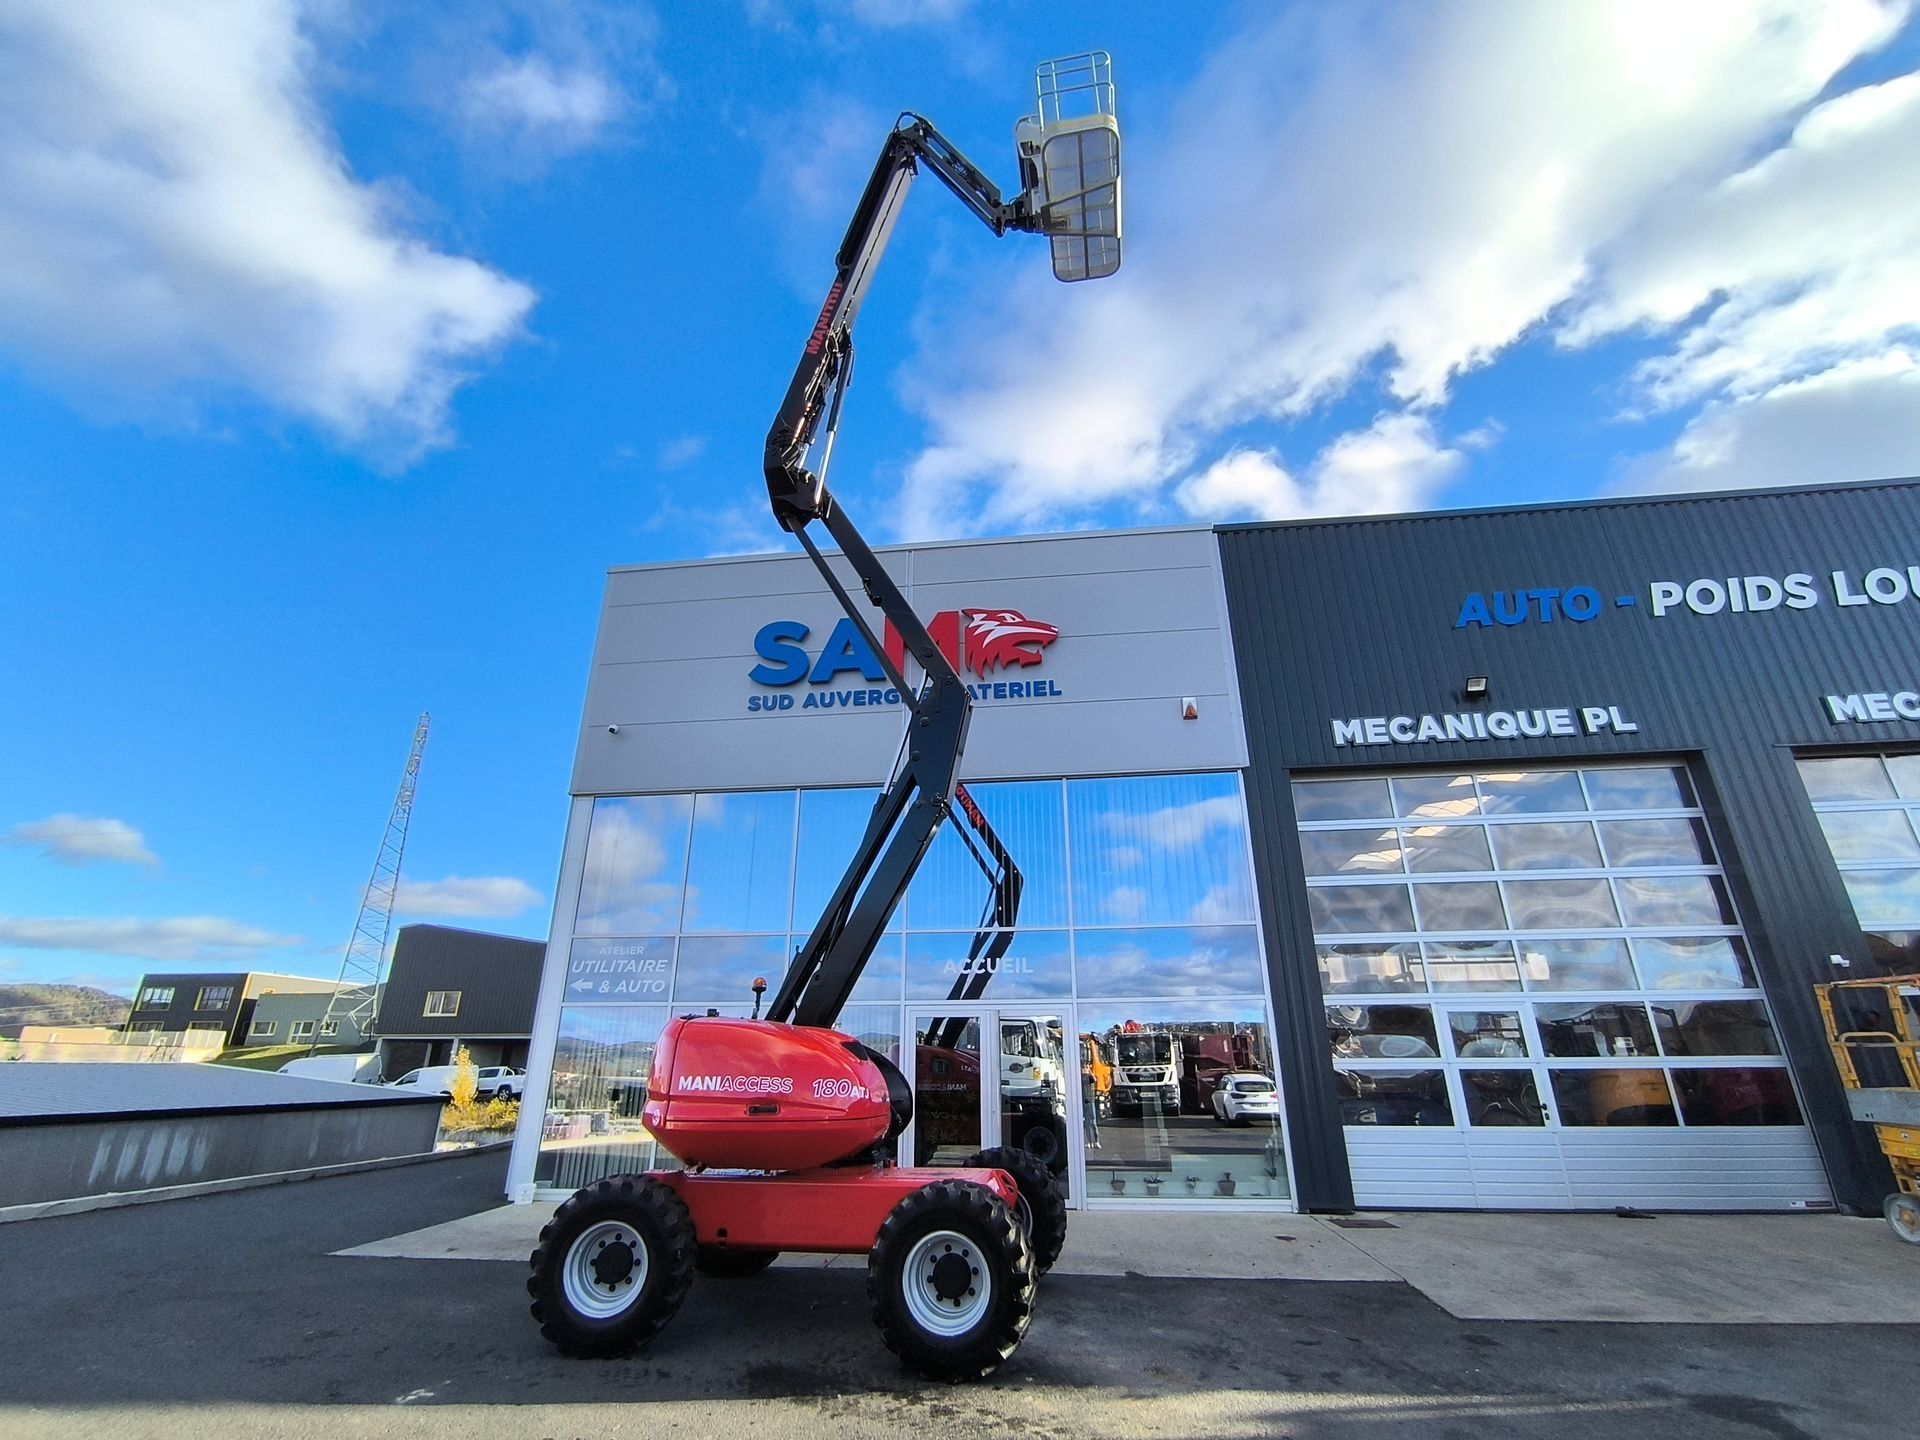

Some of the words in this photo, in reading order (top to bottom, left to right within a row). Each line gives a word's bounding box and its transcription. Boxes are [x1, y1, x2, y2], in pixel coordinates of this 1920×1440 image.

[1456, 586, 1600, 628] AUTO
[1650, 574, 1817, 617] POIDS
[748, 694, 794, 711] SUD
[802, 686, 931, 708] AUVERG
[966, 680, 1062, 700] ATERIEL
[1332, 707, 1576, 747] MECANIQUE
[1582, 706, 1637, 735] PL
[600, 946, 644, 955] ATELIER
[572, 959, 668, 973] UTILITAIRE
[943, 957, 1033, 974] ACCUEIL
[599, 980, 610, 993] &
[614, 980, 665, 993] AUTO
[679, 1075, 793, 1094] MANIACCESS
